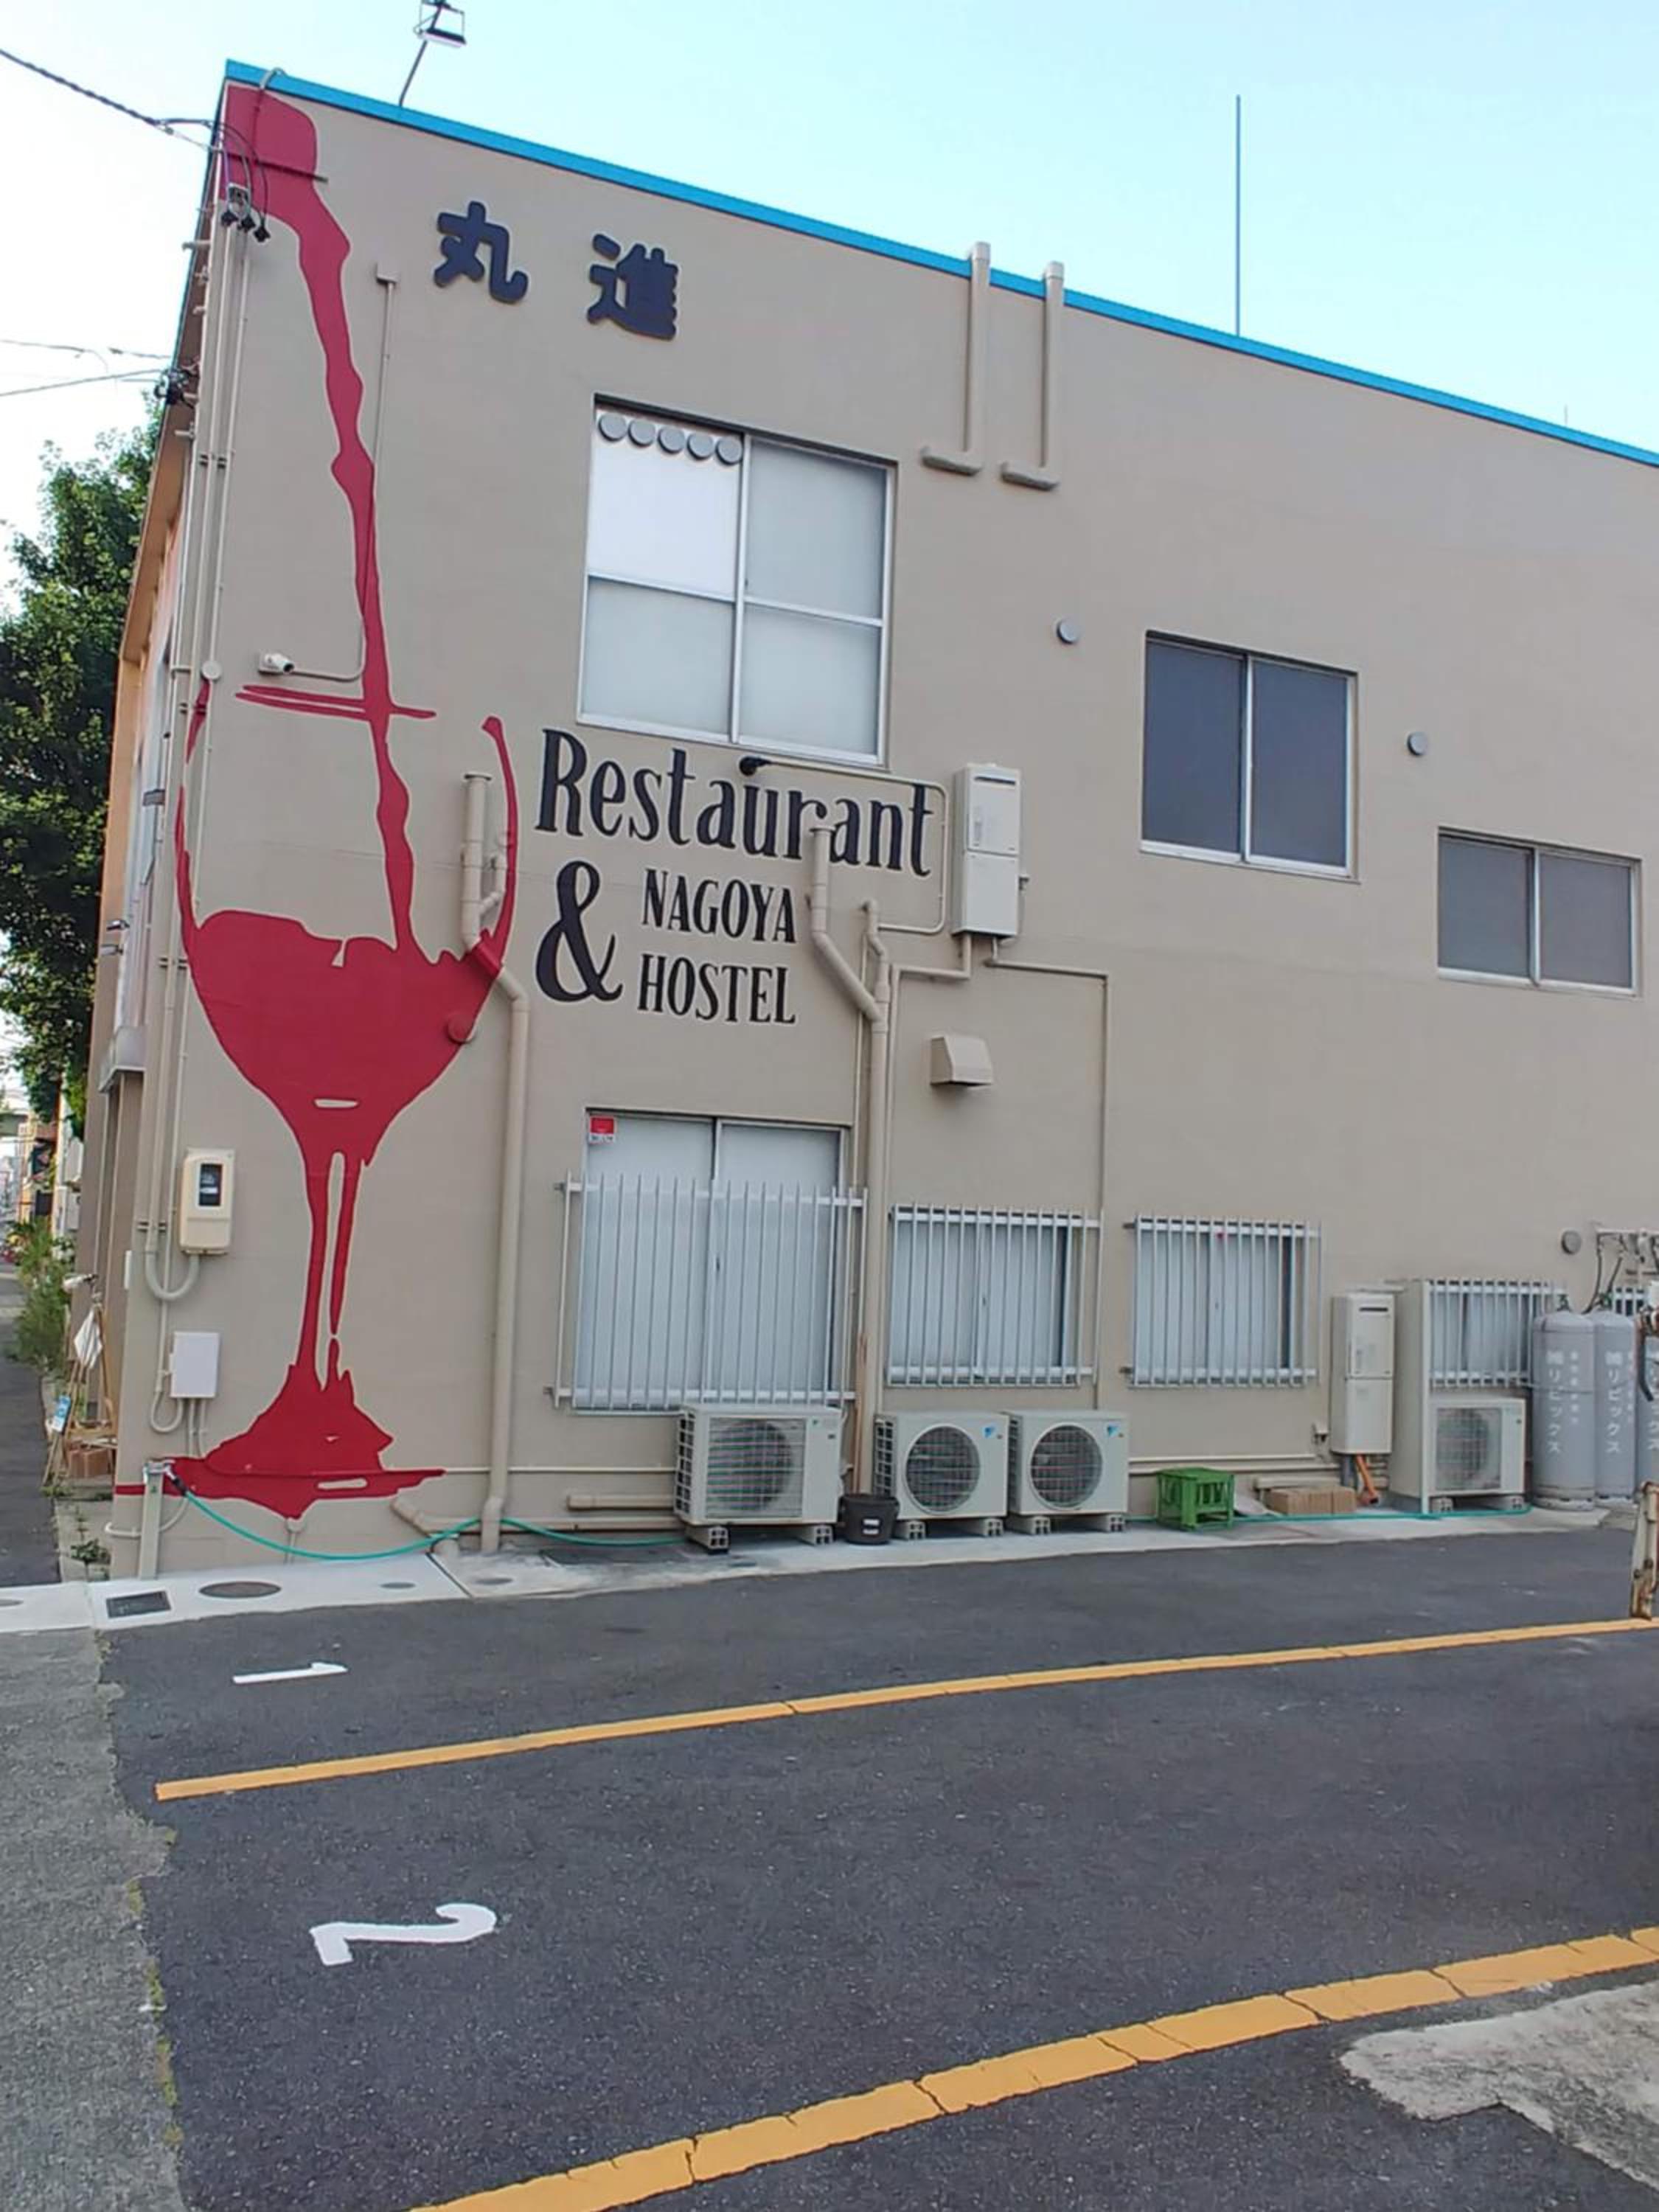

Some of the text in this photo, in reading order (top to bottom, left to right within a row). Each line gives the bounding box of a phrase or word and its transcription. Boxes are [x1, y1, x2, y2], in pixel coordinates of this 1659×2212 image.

[433, 200, 680, 341] 丸進
[535, 728, 933, 877] Restaurant
[535, 860, 623, 1003] &
[641, 869, 796, 944] NAGOYA
[637, 953, 796, 1024] HOSTEL
